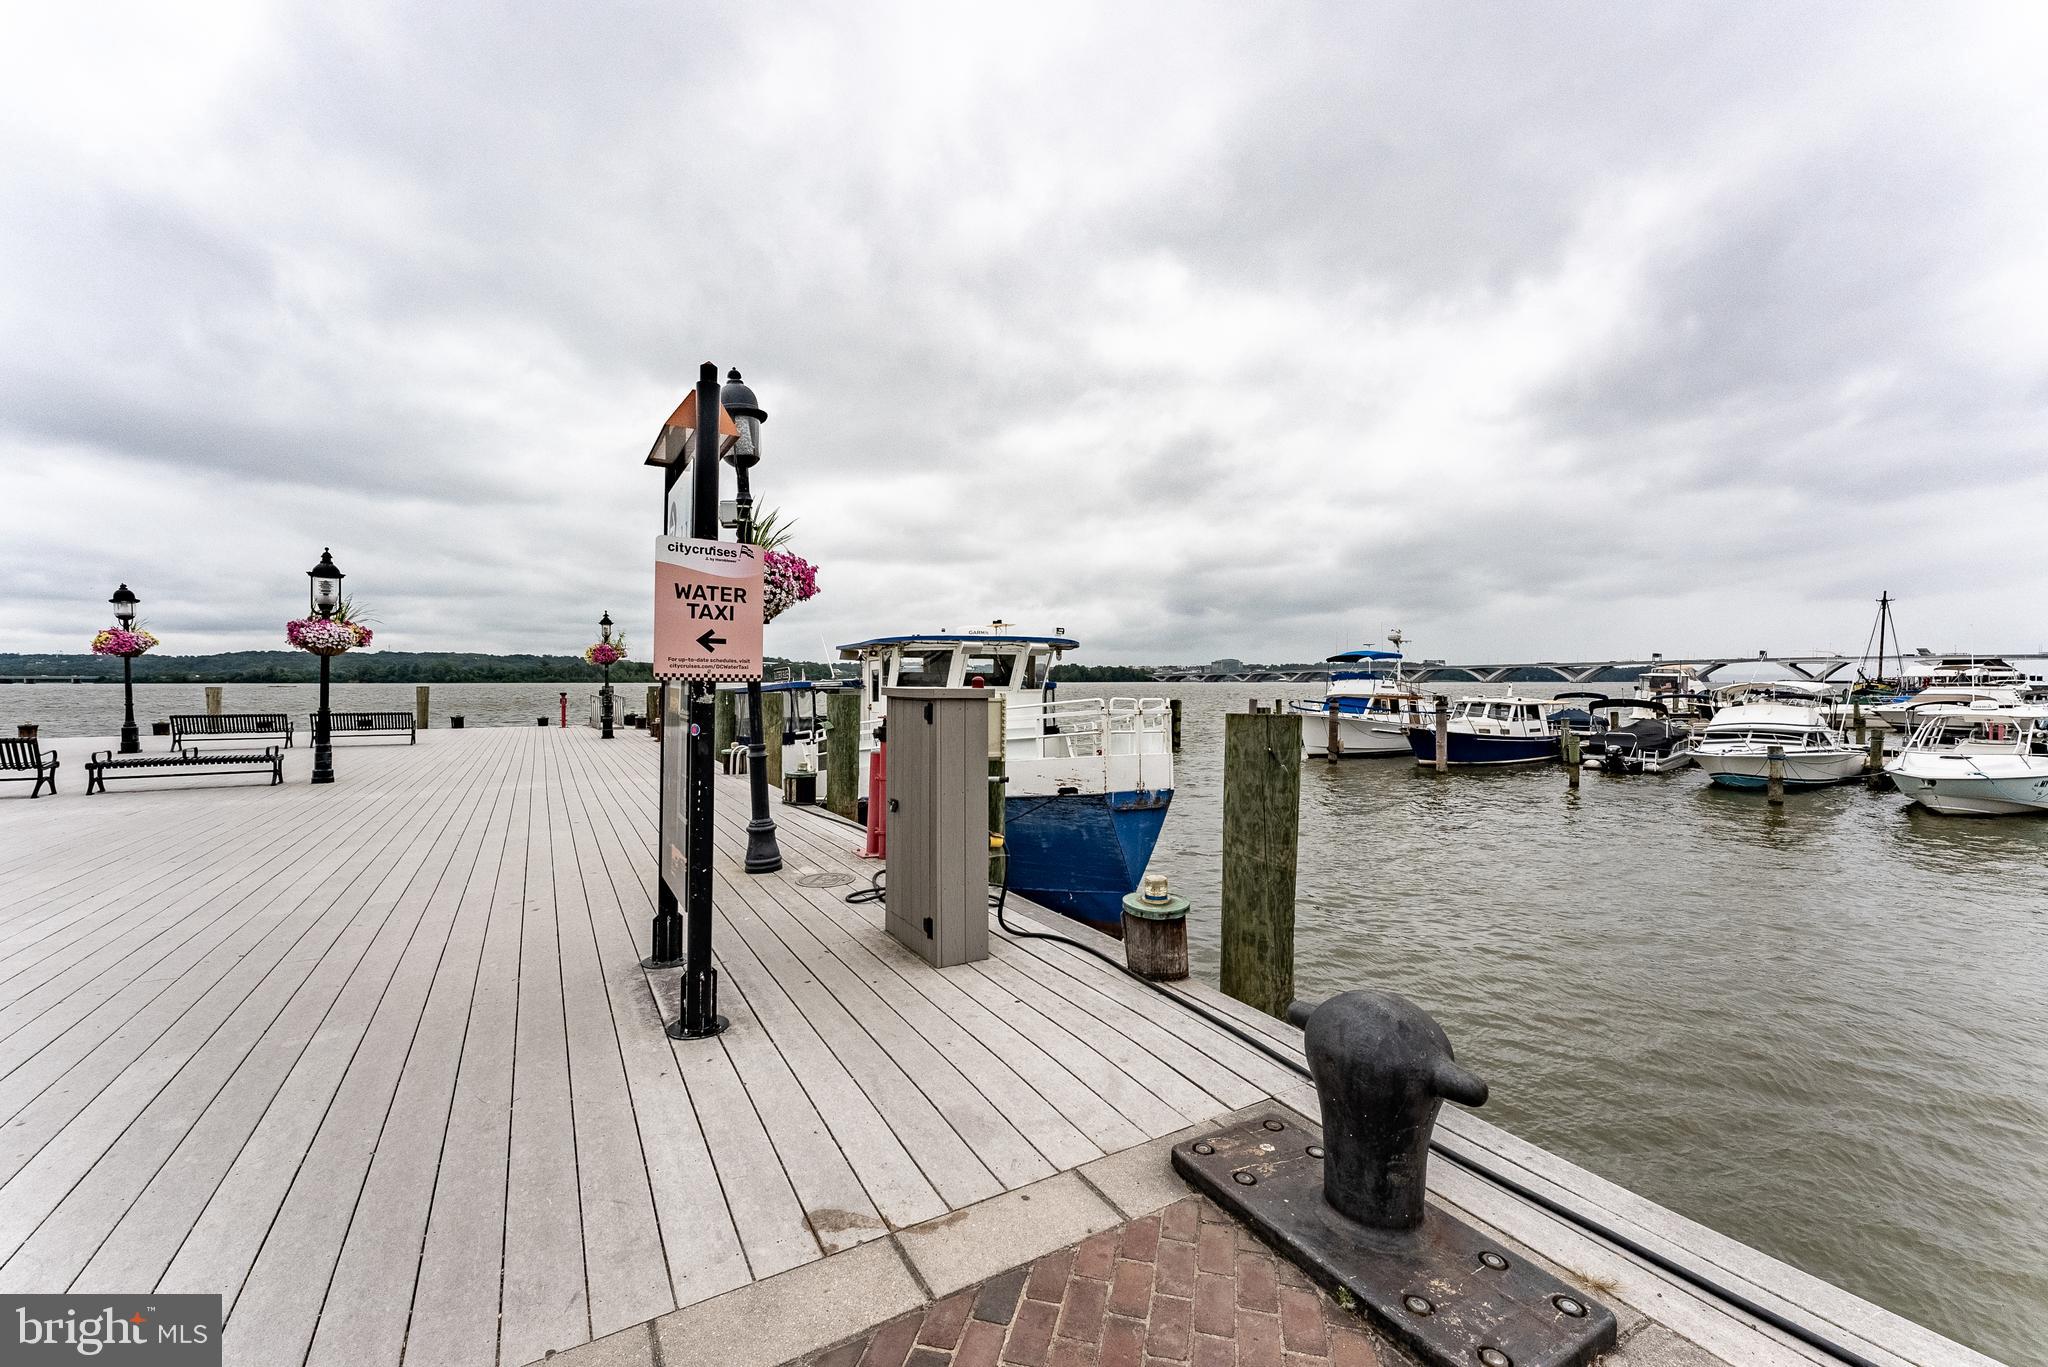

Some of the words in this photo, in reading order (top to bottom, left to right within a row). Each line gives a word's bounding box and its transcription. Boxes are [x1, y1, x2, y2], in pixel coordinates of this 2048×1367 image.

[667, 542, 738, 558] citycruises
[674, 582, 747, 604] WATER
[686, 602, 734, 621] TAXI
